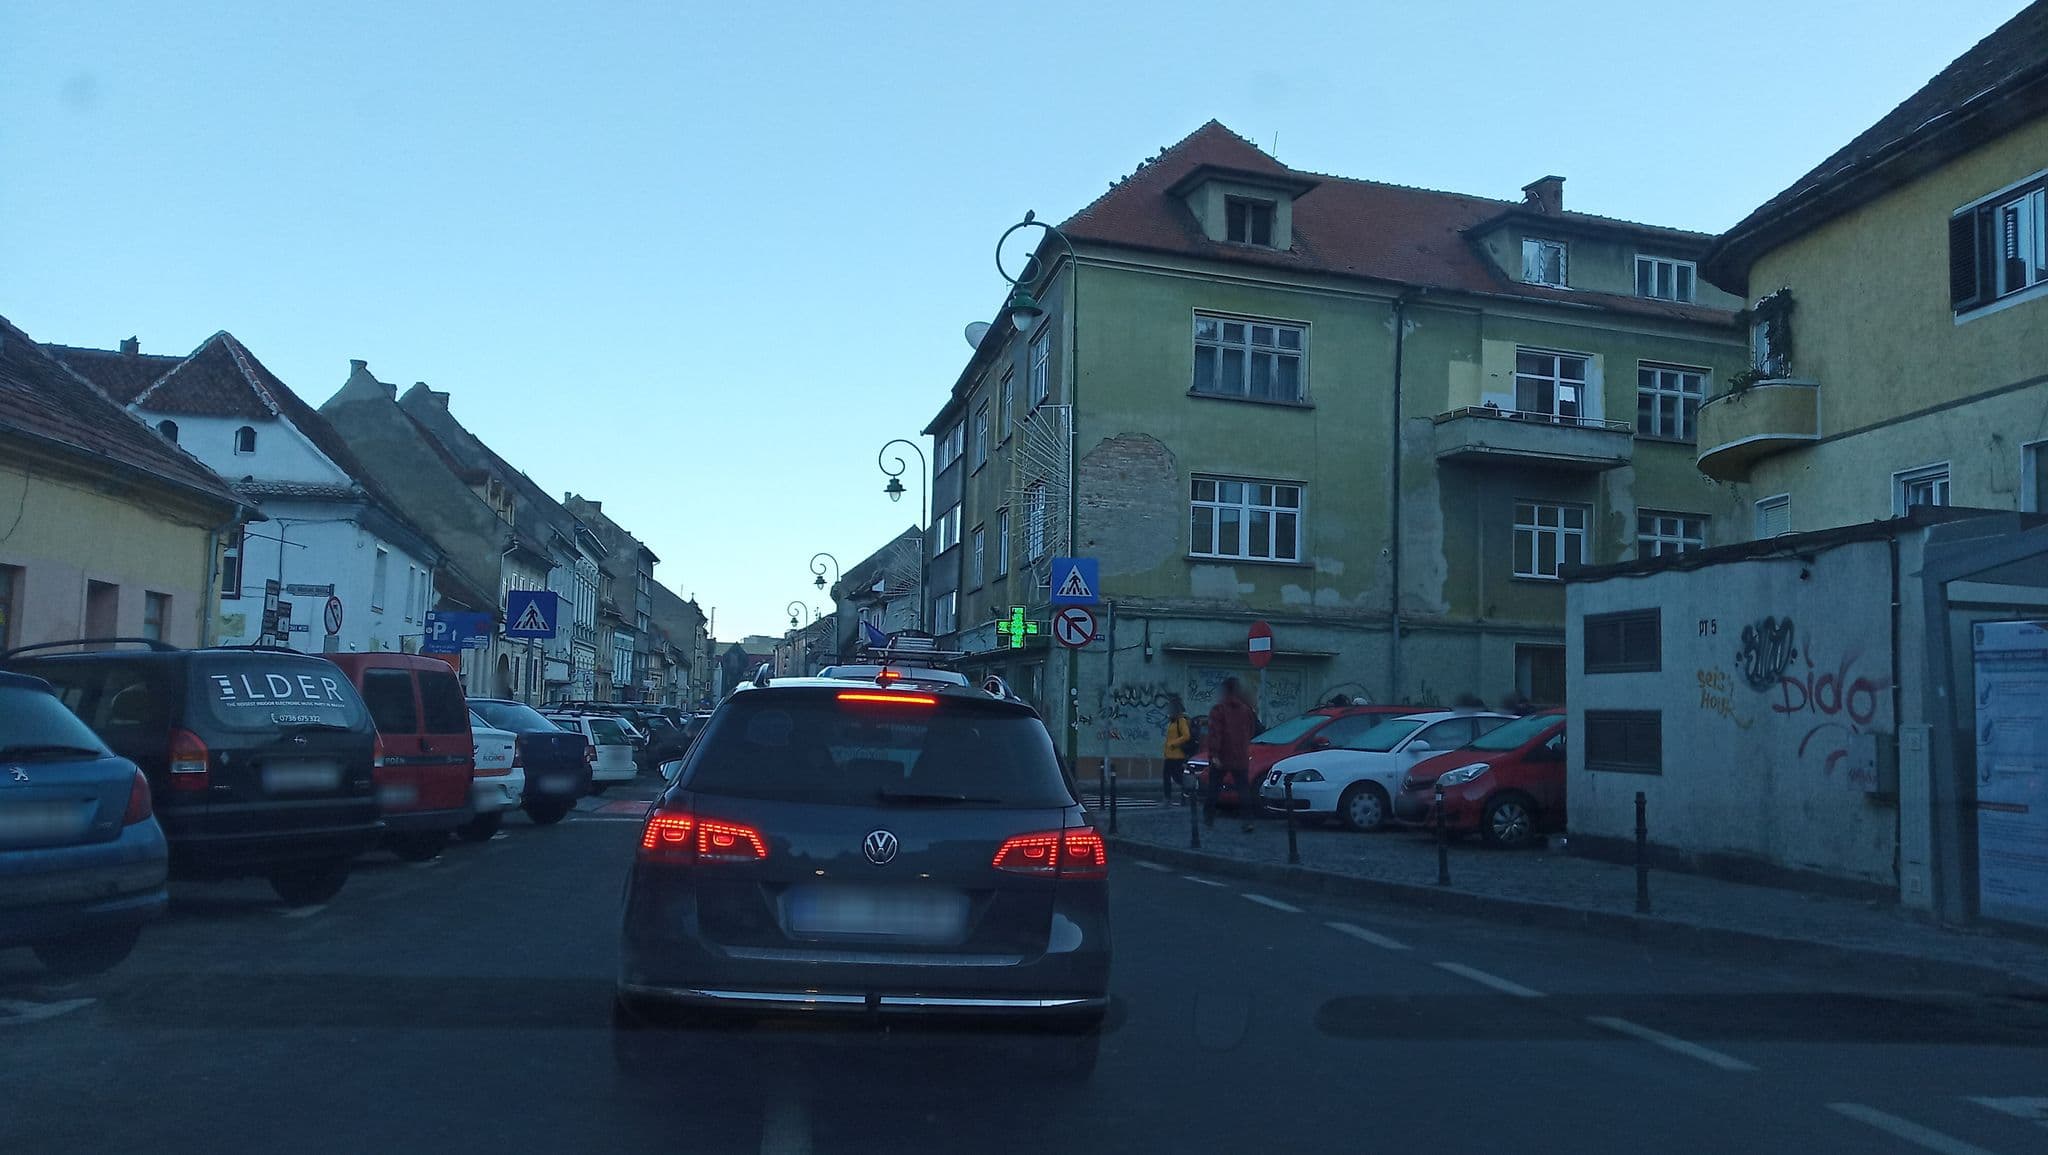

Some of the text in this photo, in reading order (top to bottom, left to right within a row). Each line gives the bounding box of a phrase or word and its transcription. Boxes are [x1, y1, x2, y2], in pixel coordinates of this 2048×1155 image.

[432, 621, 447, 641] P
[1711, 618, 1717, 634] 5
[210, 673, 344, 701] ELDER
